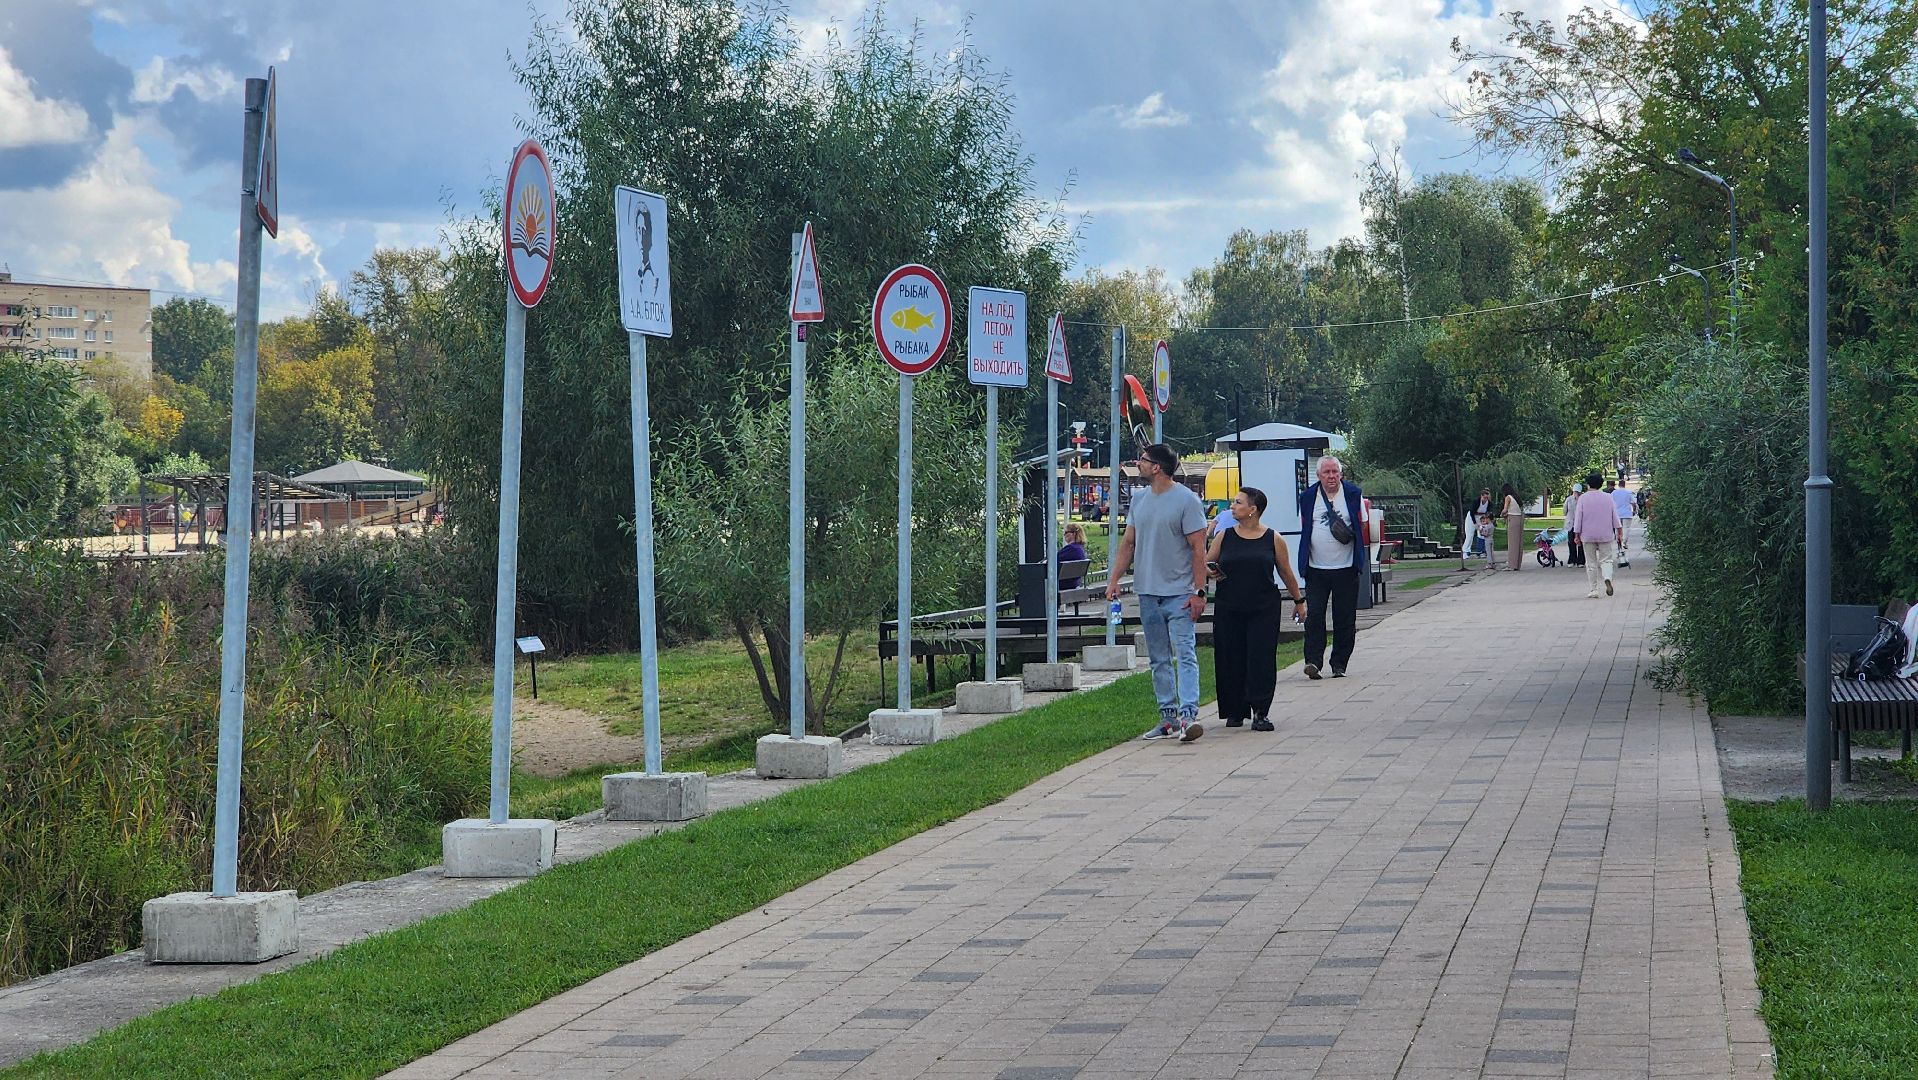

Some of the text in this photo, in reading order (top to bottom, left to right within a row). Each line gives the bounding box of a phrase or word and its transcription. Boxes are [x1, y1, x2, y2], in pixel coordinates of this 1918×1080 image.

[899, 284, 929, 299] РЫБАК
[644, 300, 666, 323] БЛОК
[981, 300, 1015, 320] НА ЛЁД
[983, 320, 1013, 337] ЛЕТОМ
[894, 340, 930, 355] РЫБАКА
[992, 341, 1004, 355] НЕ
[973, 358, 1024, 376] ВЫХОДИТЬ
